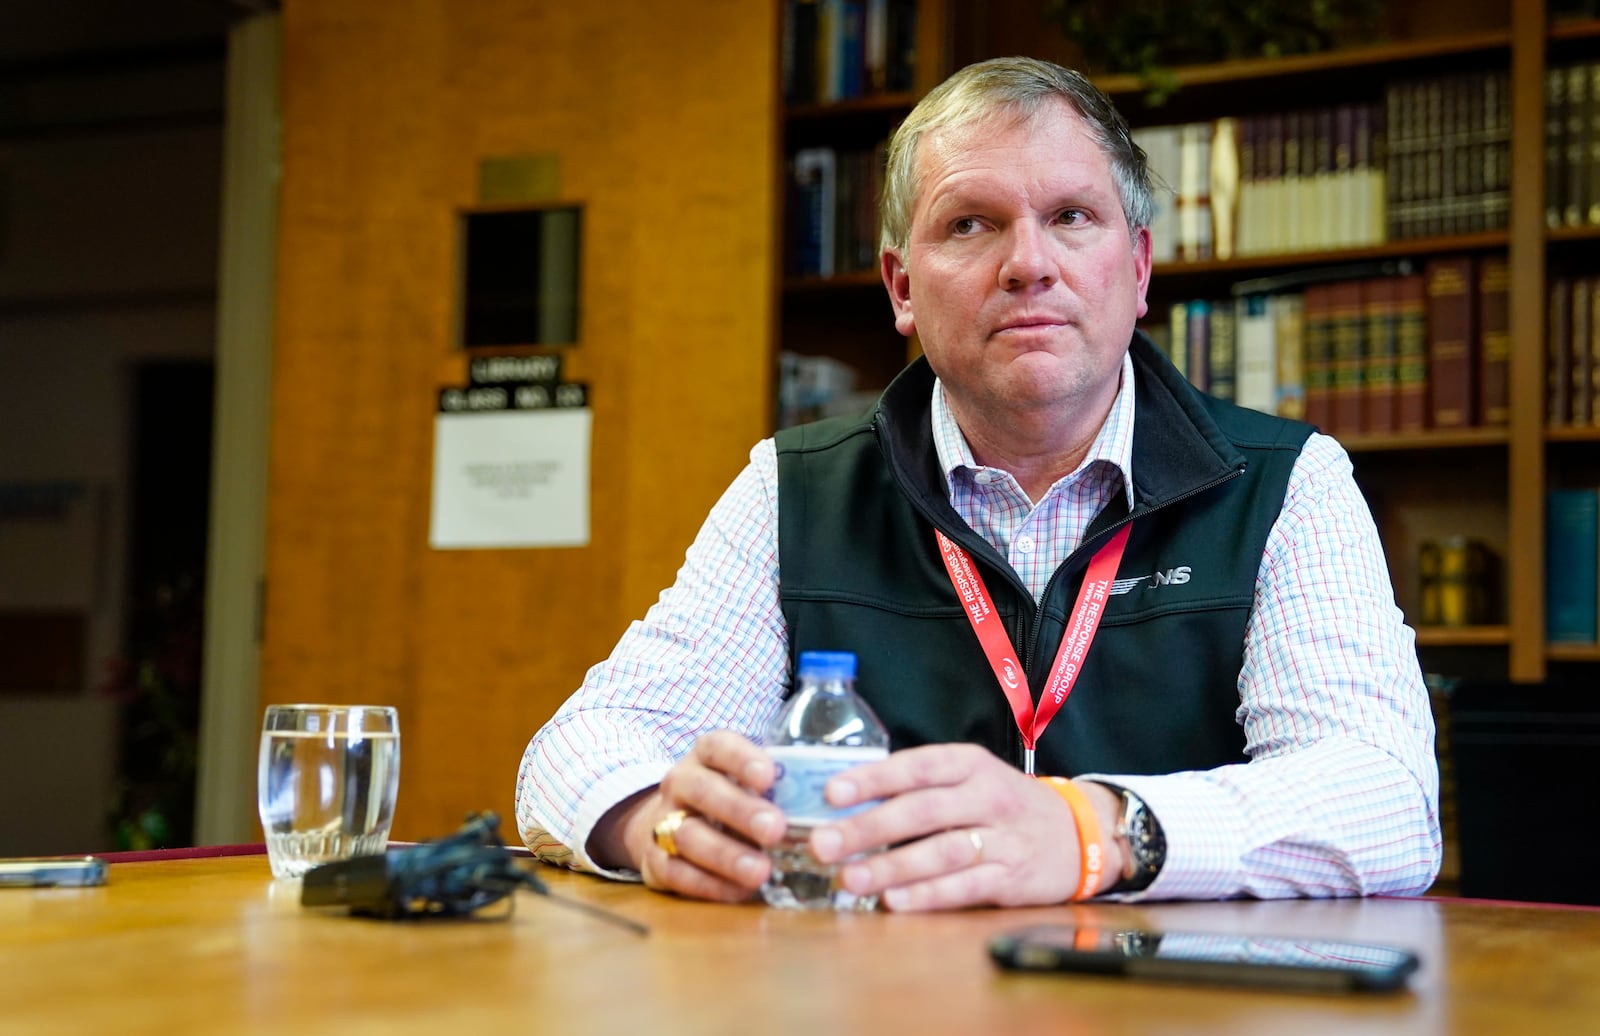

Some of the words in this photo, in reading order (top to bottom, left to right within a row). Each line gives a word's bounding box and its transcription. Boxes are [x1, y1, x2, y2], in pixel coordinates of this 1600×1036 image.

[472, 356, 557, 382] LIBRARY
[441, 387, 508, 410] CLASS
[947, 551, 975, 602] RESPONSE
[1147, 566, 1192, 589] NS
[1093, 579, 1108, 602] THE
[969, 603, 985, 624] THE
[1049, 582, 1096, 694] www.responsegroupinc.com
[1070, 602, 1100, 663] RESPONSE
[1054, 664, 1076, 704] GROUP
